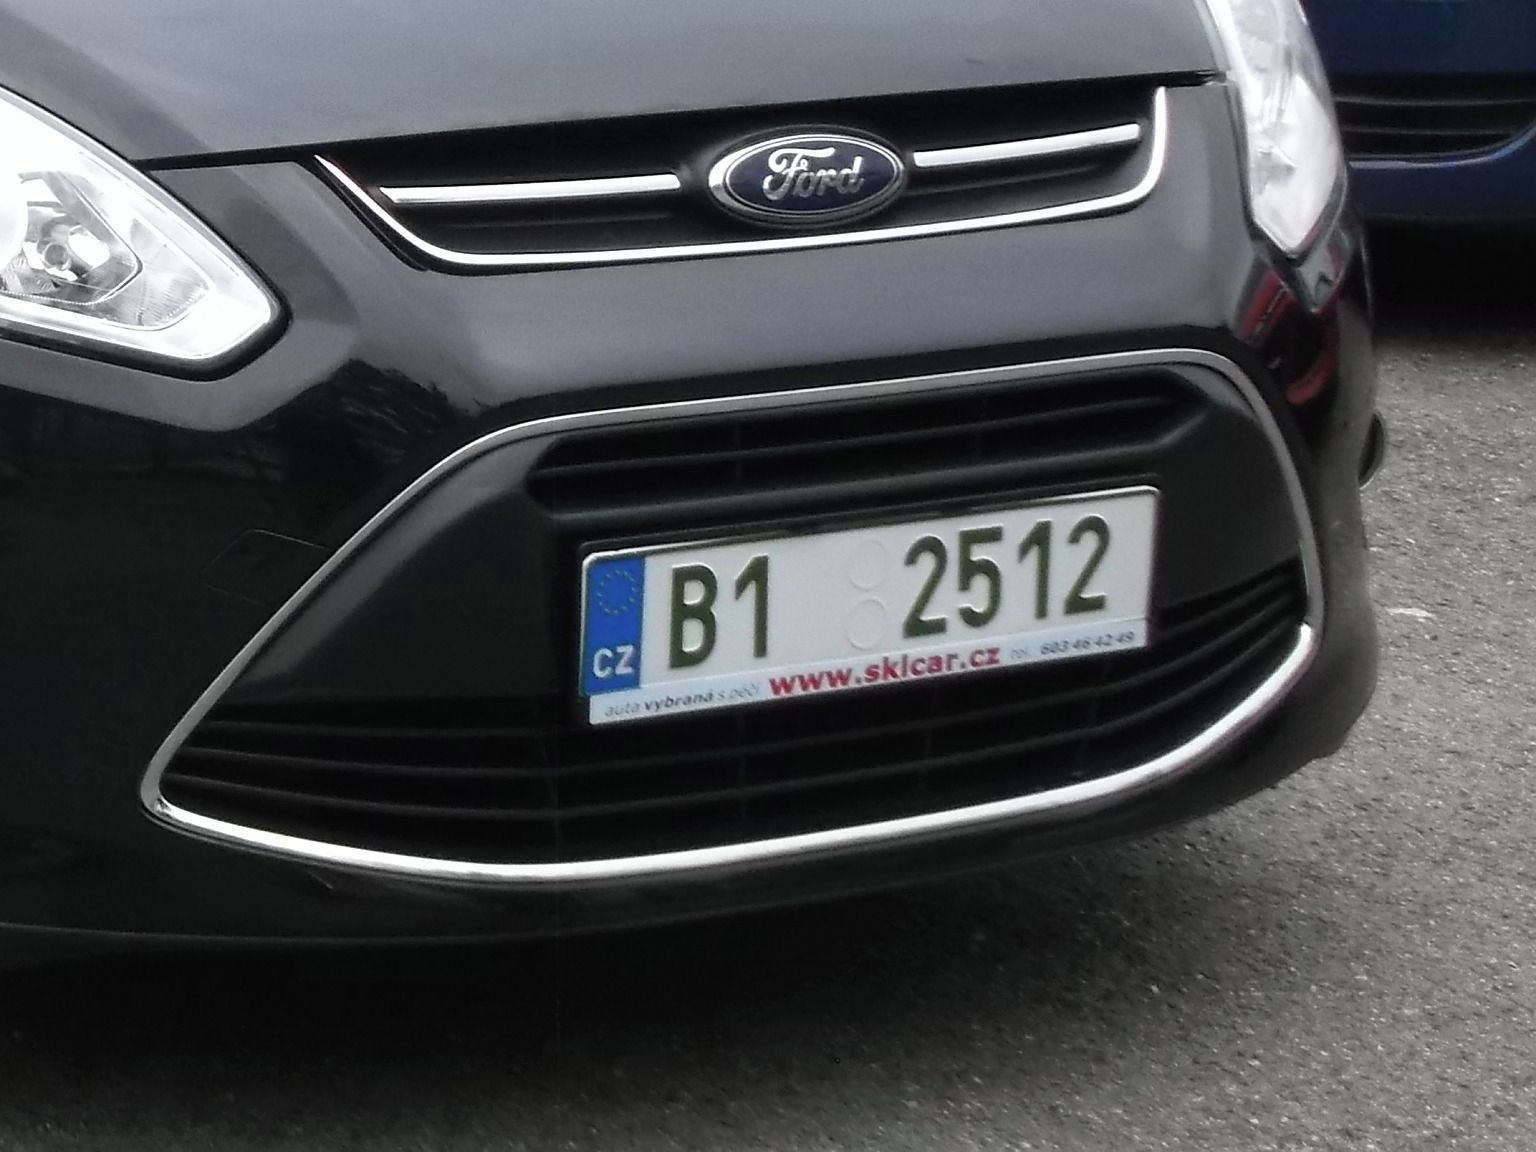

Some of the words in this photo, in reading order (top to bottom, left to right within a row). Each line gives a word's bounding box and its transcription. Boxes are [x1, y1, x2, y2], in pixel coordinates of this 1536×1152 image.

[762, 147, 865, 201] Ford
[668, 553, 769, 669] B1
[902, 513, 1110, 638] 2512
[592, 644, 634, 678] CZ
